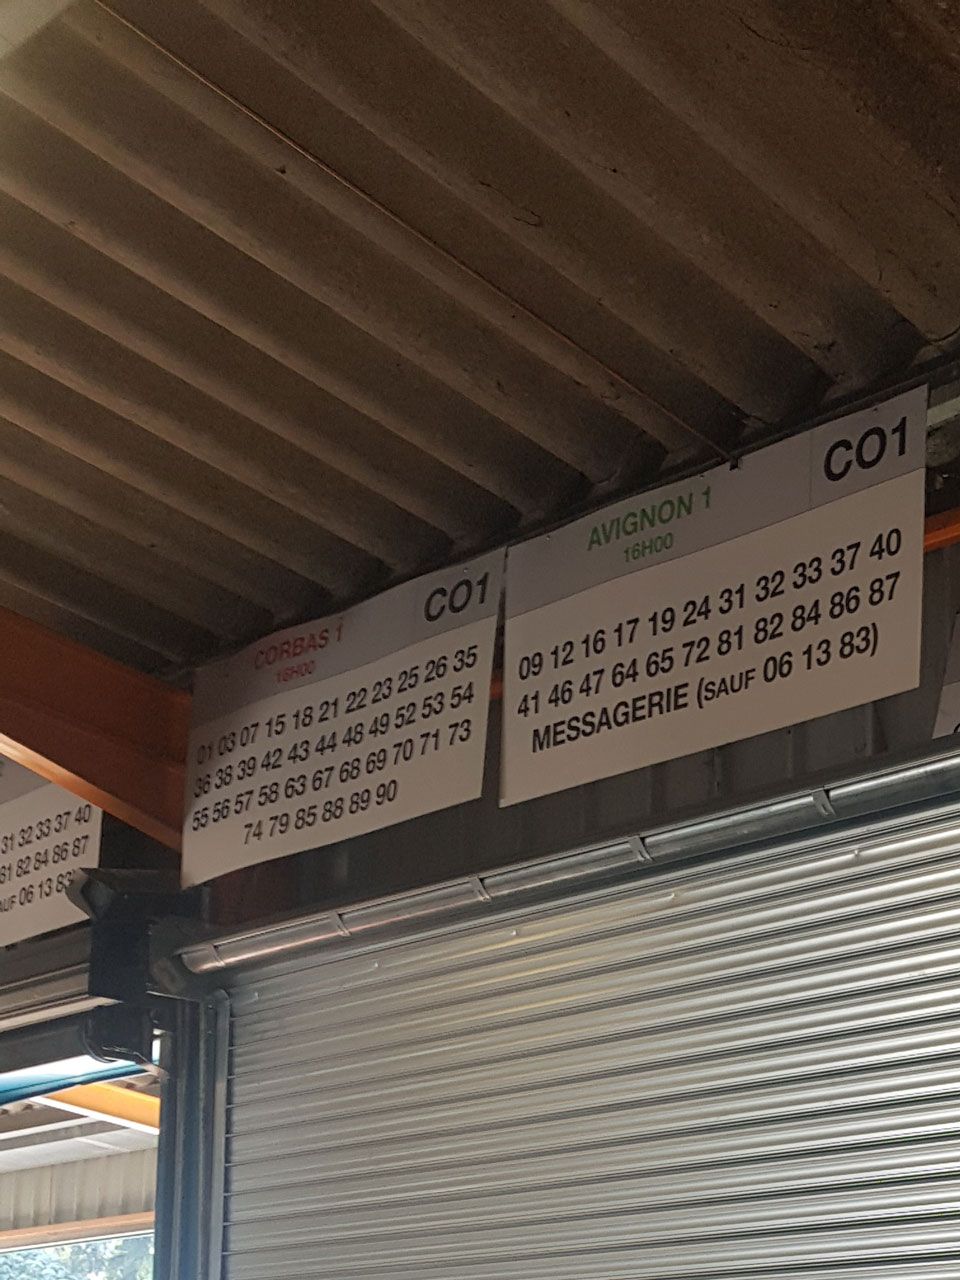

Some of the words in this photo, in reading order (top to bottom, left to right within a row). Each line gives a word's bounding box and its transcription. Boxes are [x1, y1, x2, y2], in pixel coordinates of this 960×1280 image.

[823, 416, 908, 482] CO1
[586, 491, 694, 552] AVIGNON
[702, 485, 713, 510] 1
[622, 531, 674, 564] 16H00
[423, 572, 490, 622] CO1
[518, 652, 543, 681] 09
[550, 640, 574, 668] 12
[581, 629, 606, 657] 16
[613, 617, 640, 647] 17
[648, 606, 676, 637] 19
[682, 595, 711, 627] 24
[718, 584, 745, 615] 31
[755, 570, 785, 604] 32
[793, 555, 822, 590] 33
[831, 541, 861, 577] 37
[869, 527, 902, 563] 40
[254, 628, 329, 669] CORBAS
[517, 690, 540, 718] 41
[548, 679, 573, 707] 46
[578, 669, 606, 698] 47
[611, 657, 638, 689] 64
[645, 646, 674, 679] 65
[681, 636, 711, 669] 72
[716, 624, 744, 658] 81
[753, 612, 784, 646] 82
[790, 599, 822, 634] 84
[829, 585, 861, 620] 86
[869, 571, 901, 607] 87
[218, 731, 236, 756] 03
[240, 722, 260, 747] 07
[265, 713, 286, 738] 15
[292, 706, 313, 730] 18
[318, 697, 339, 722] 21
[345, 688, 367, 714] 22
[371, 677, 393, 704] 23
[397, 666, 419, 693] 25
[424, 655, 448, 683] 26
[453, 645, 478, 672] 35
[532, 683, 689, 754] MESSAGERIE
[696, 668, 756, 710] (SAUF
[763, 650, 793, 684] 06
[802, 638, 831, 671] 13
[838, 622, 879, 660] 83)
[214, 764, 233, 790] 38
[237, 756, 256, 780] 39
[261, 748, 283, 772] 42
[287, 740, 310, 764] 43
[315, 731, 337, 756] 44
[342, 722, 364, 747] 48
[369, 712, 390, 738] 49
[394, 702, 417, 729] 52
[421, 691, 444, 719] 53
[450, 681, 474, 709] 54
[192, 807, 209, 831] 55
[212, 798, 230, 823] 56
[234, 789, 254, 815] 57
[258, 782, 279, 806] 58
[285, 774, 307, 799] 63
[312, 766, 334, 791] 67
[340, 757, 361, 783] 68
[366, 748, 387, 774] 69
[393, 738, 414, 766] 70
[420, 728, 440, 755] 71
[448, 718, 472, 746] 73
[18, 825, 33, 847] 32
[36, 818, 51, 840] 33
[54, 811, 71, 833] 37
[75, 804, 91, 825] 40
[244, 819, 262, 845] 74
[269, 812, 289, 837] 79
[294, 805, 317, 830] 85
[322, 797, 344, 822] 88
[375, 779, 397, 805] 90
[16, 856, 31, 877] 82
[52, 842, 69, 863] 86
[72, 834, 89, 857] 87
[19, 884, 34, 905] 06
[38, 878, 53, 899] 13
